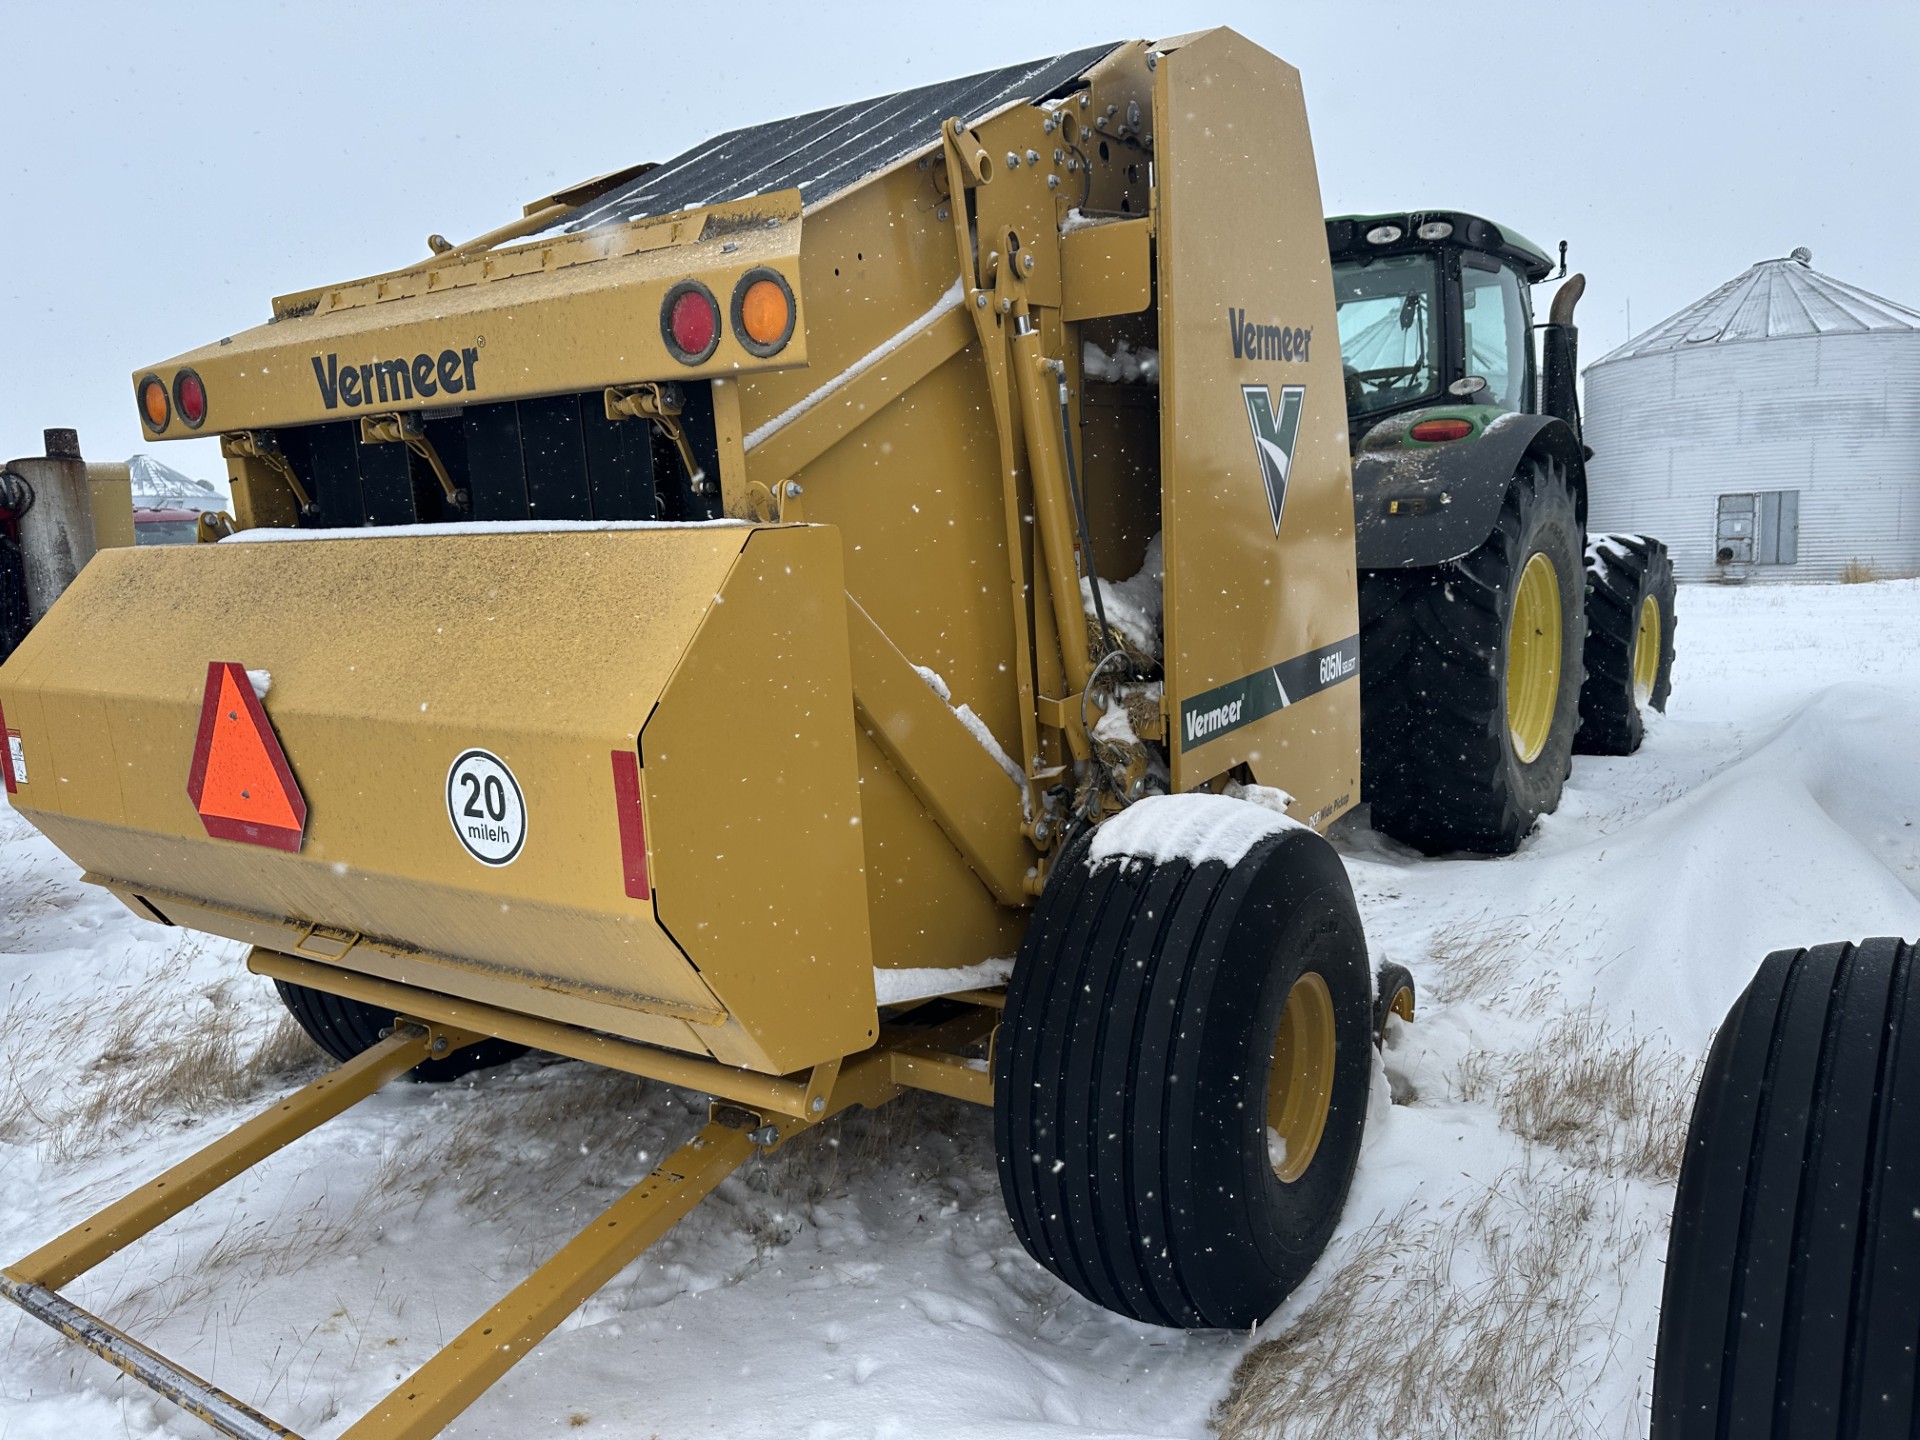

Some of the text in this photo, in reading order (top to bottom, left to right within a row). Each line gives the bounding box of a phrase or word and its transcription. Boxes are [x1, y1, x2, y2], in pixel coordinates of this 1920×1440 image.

[1229, 307, 1312, 363] Vermeer
[310, 345, 480, 410] Vermeer
[1319, 650, 1342, 685] 605N
[1185, 698, 1244, 742] Vermeer
[460, 772, 507, 822] 20
[467, 823, 510, 844] mile/h
